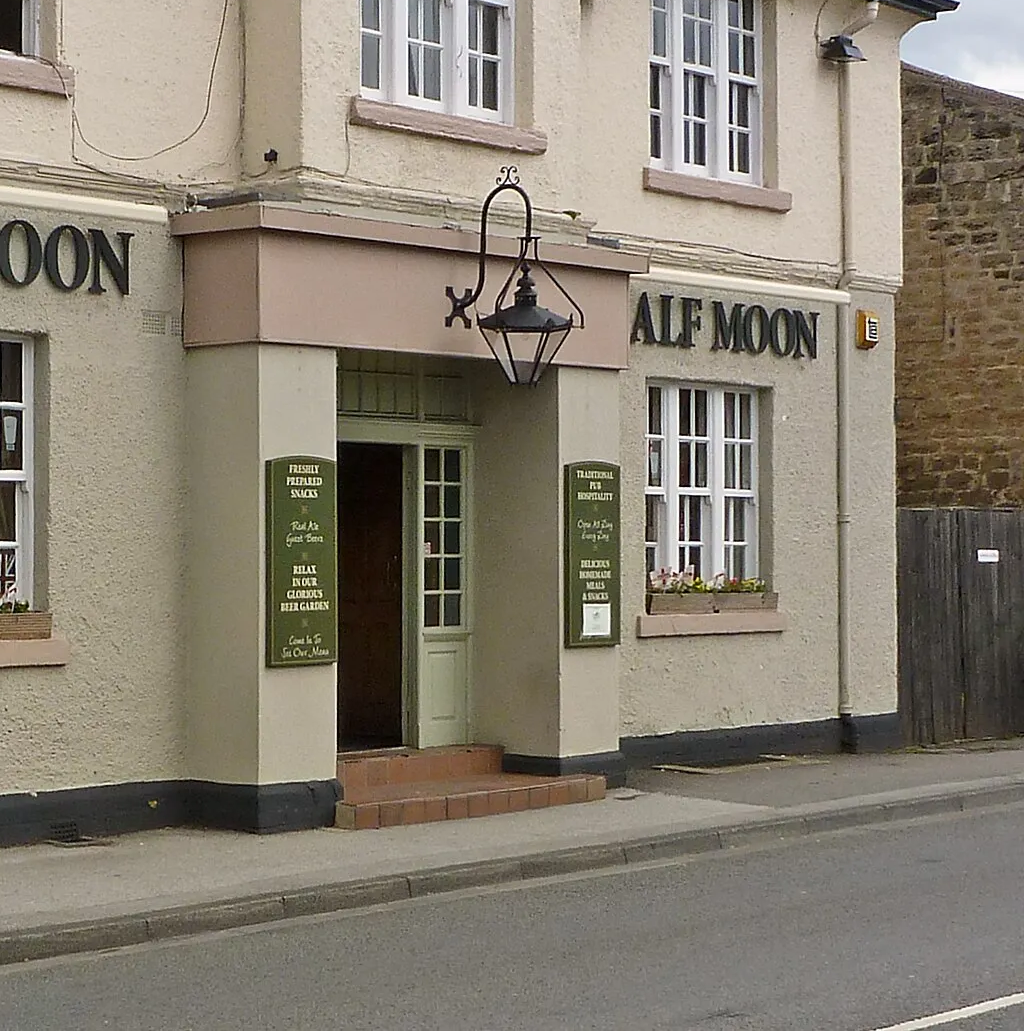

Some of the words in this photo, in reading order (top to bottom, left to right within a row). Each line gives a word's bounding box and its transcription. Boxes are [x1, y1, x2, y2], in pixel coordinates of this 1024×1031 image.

[629, 291, 703, 349] ALF
[709, 300, 821, 360] MOON
[288, 464, 320, 474] FRESHLY
[286, 476, 323, 486] PREPARED
[589, 481, 602, 490] PUB
[290, 488, 318, 499] SNACKS
[577, 491, 614, 501] HOSPITALITY
[292, 565, 317, 575] RELAX
[579, 570, 612, 579] HOMEMADE
[292, 577, 301, 587] IN
[301, 577, 318, 587] OUR
[586, 581, 606, 590] MEALS
[286, 589, 324, 600] GLORIOUS
[588, 592, 609, 601] SNACKS
[280, 602, 299, 612] BEER
[299, 601, 330, 612] GARDEN
